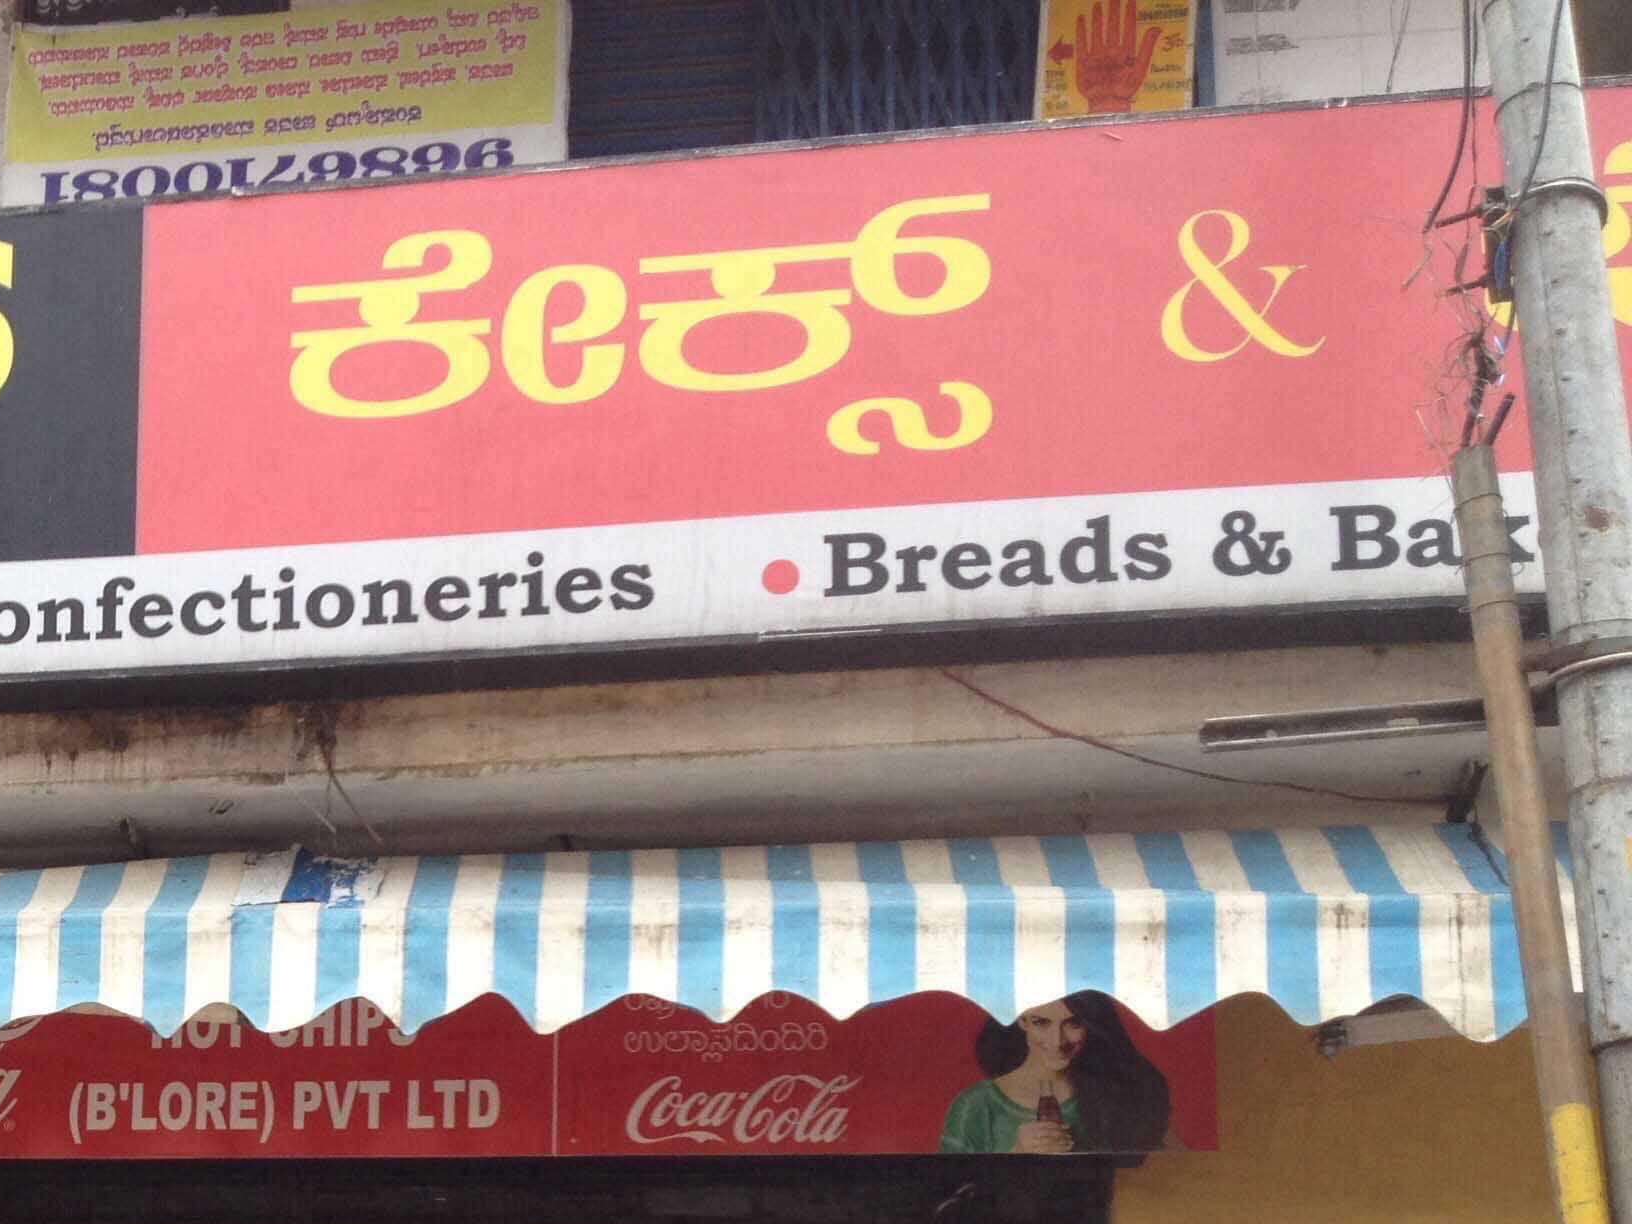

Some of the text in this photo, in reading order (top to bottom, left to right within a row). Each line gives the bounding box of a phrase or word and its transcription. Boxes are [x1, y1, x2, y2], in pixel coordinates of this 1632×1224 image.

[289, 193, 993, 456] ಕೇಕ್ಸ್
[1161, 209, 1327, 363] &
[823, 504, 1536, 599] Breads & Bak
[69, 1079, 501, 1145] (B'LORE) PVT LTD
[625, 1073, 863, 1145] Coca-Cola
